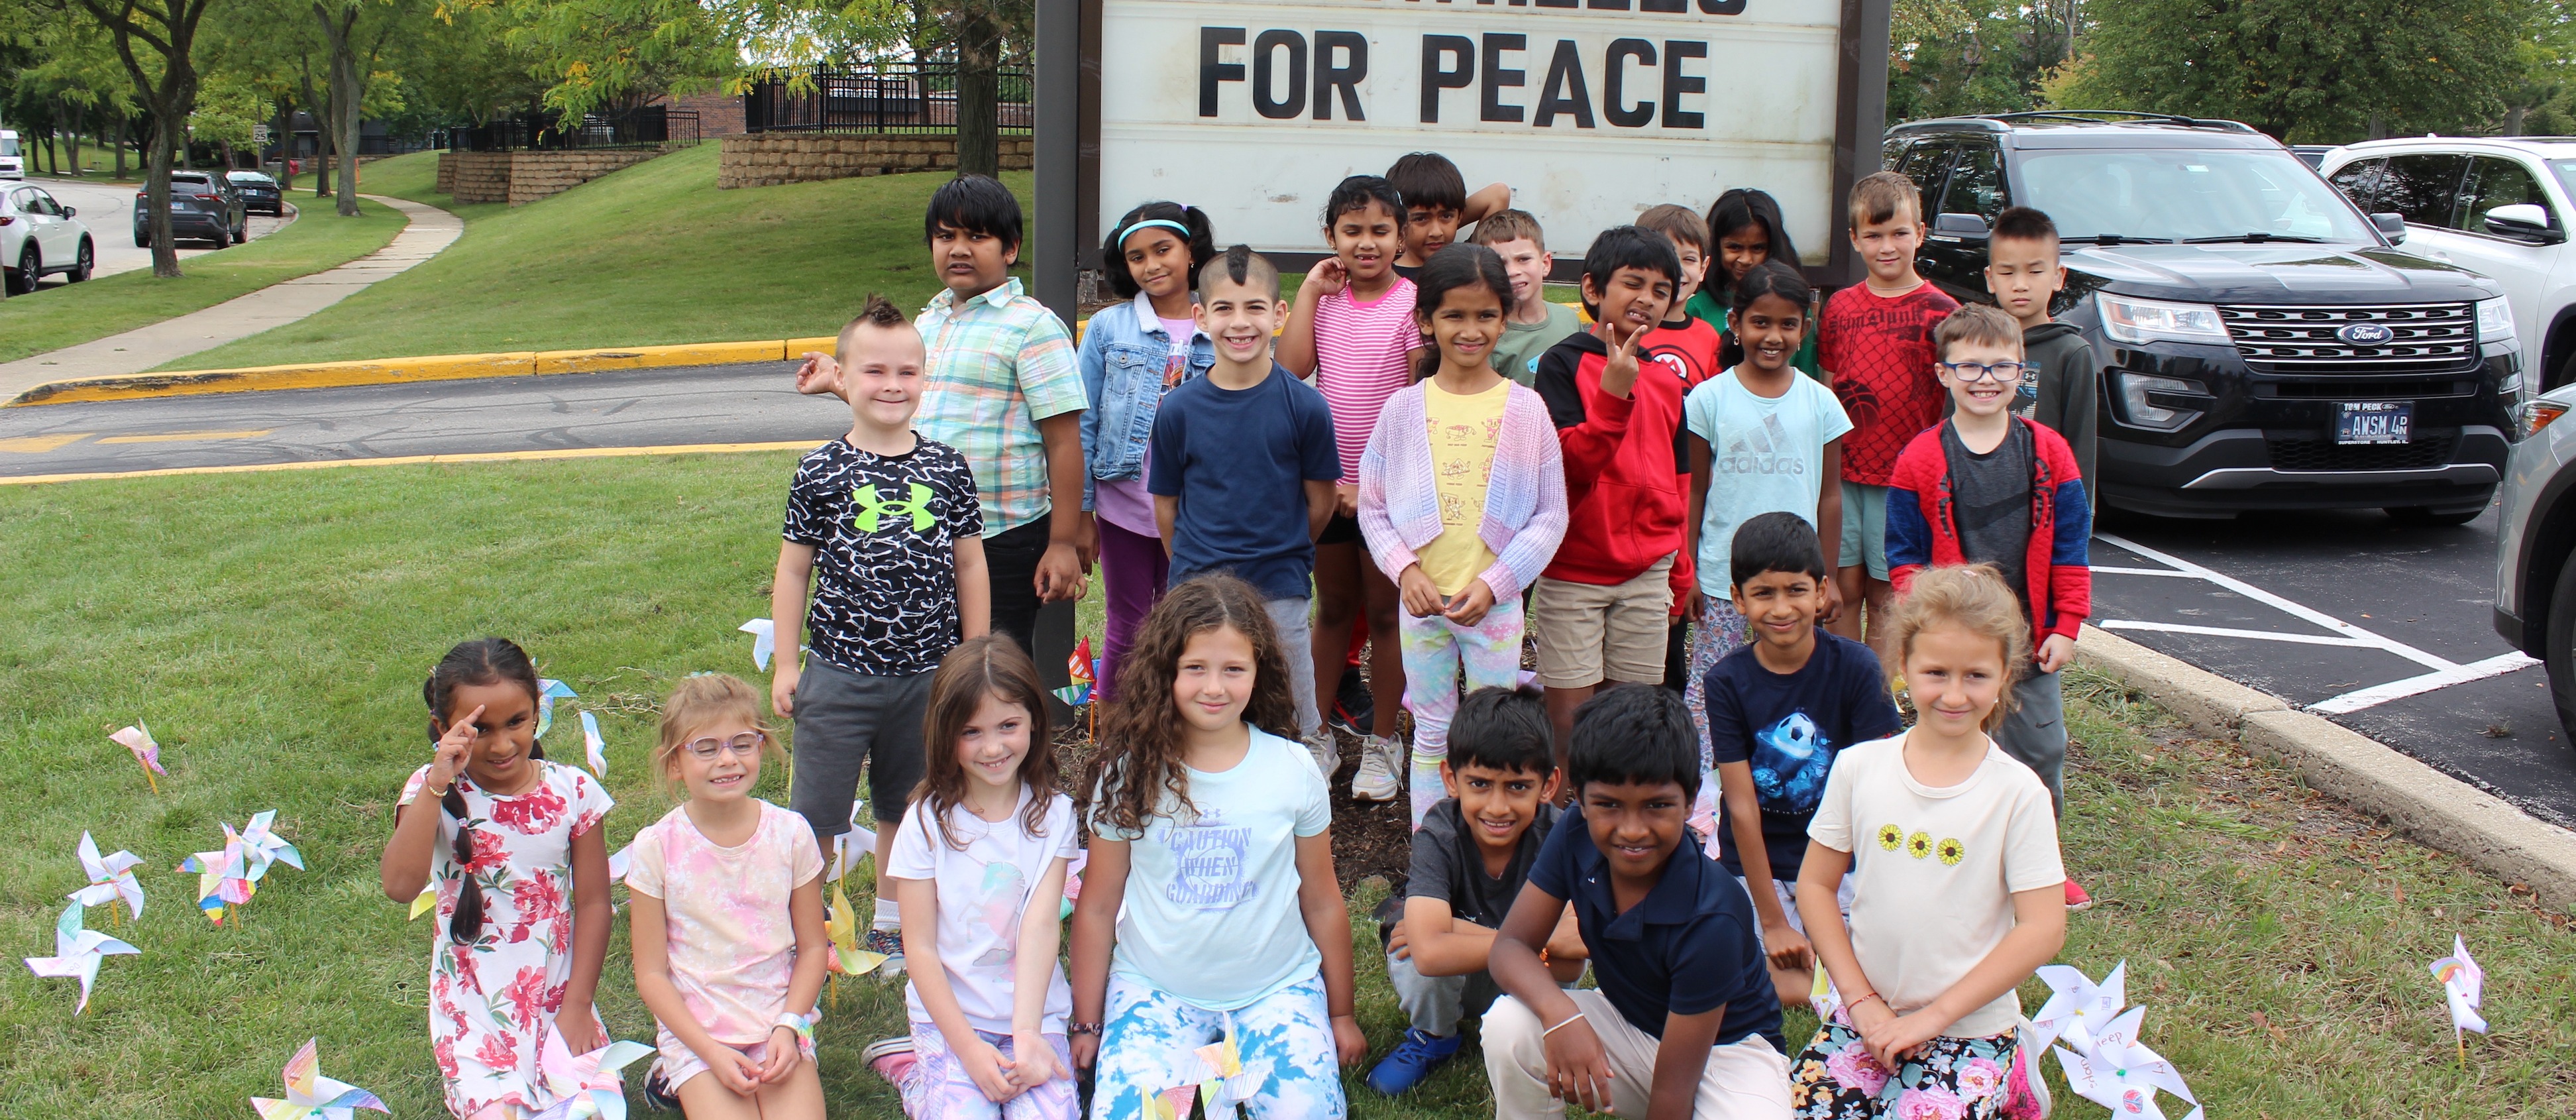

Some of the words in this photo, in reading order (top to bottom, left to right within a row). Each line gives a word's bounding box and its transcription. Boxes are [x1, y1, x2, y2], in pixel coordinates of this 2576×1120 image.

[1199, 26, 1368, 121] FOR
[1420, 32, 1708, 129] PEACE
[1866, 305, 1921, 327] Dunk
[2352, 326, 2383, 340] Ford
[2343, 402, 2361, 411] TOM
[2361, 402, 2383, 411] PECK
[2352, 416, 2388, 435] AWSM
[1718, 451, 1804, 475] adidas
[1171, 826, 1252, 852] CAUTION
[1185, 856, 1236, 877] WHEN
